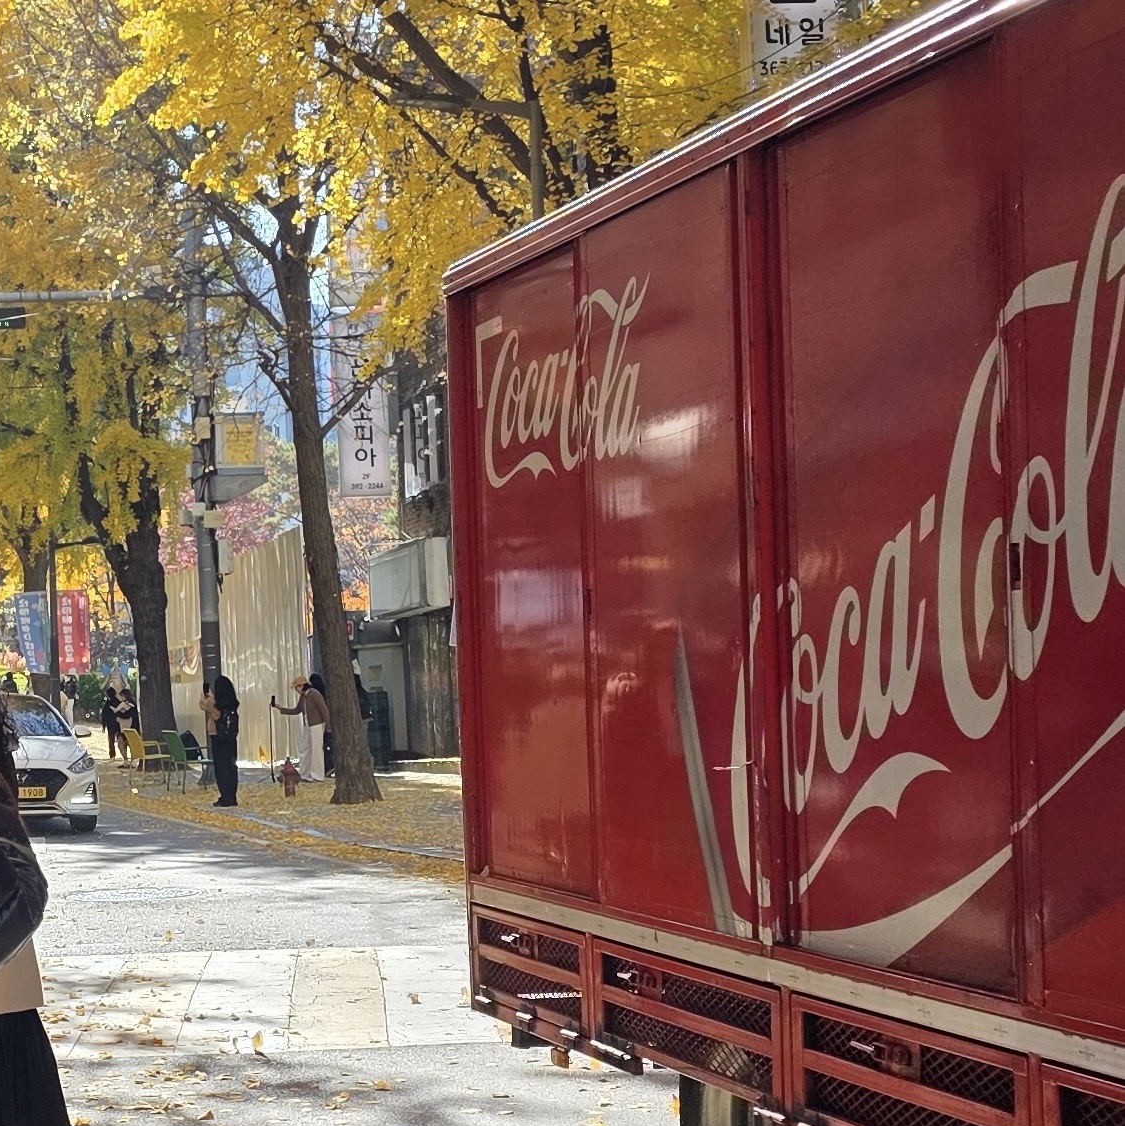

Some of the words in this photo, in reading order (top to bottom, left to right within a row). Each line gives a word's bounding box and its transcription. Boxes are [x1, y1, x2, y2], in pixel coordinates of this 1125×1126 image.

[765, 17, 824, 46] 네일
[485, 271, 651, 488] Coca-Cola
[22, 788, 44, 797] 1908
